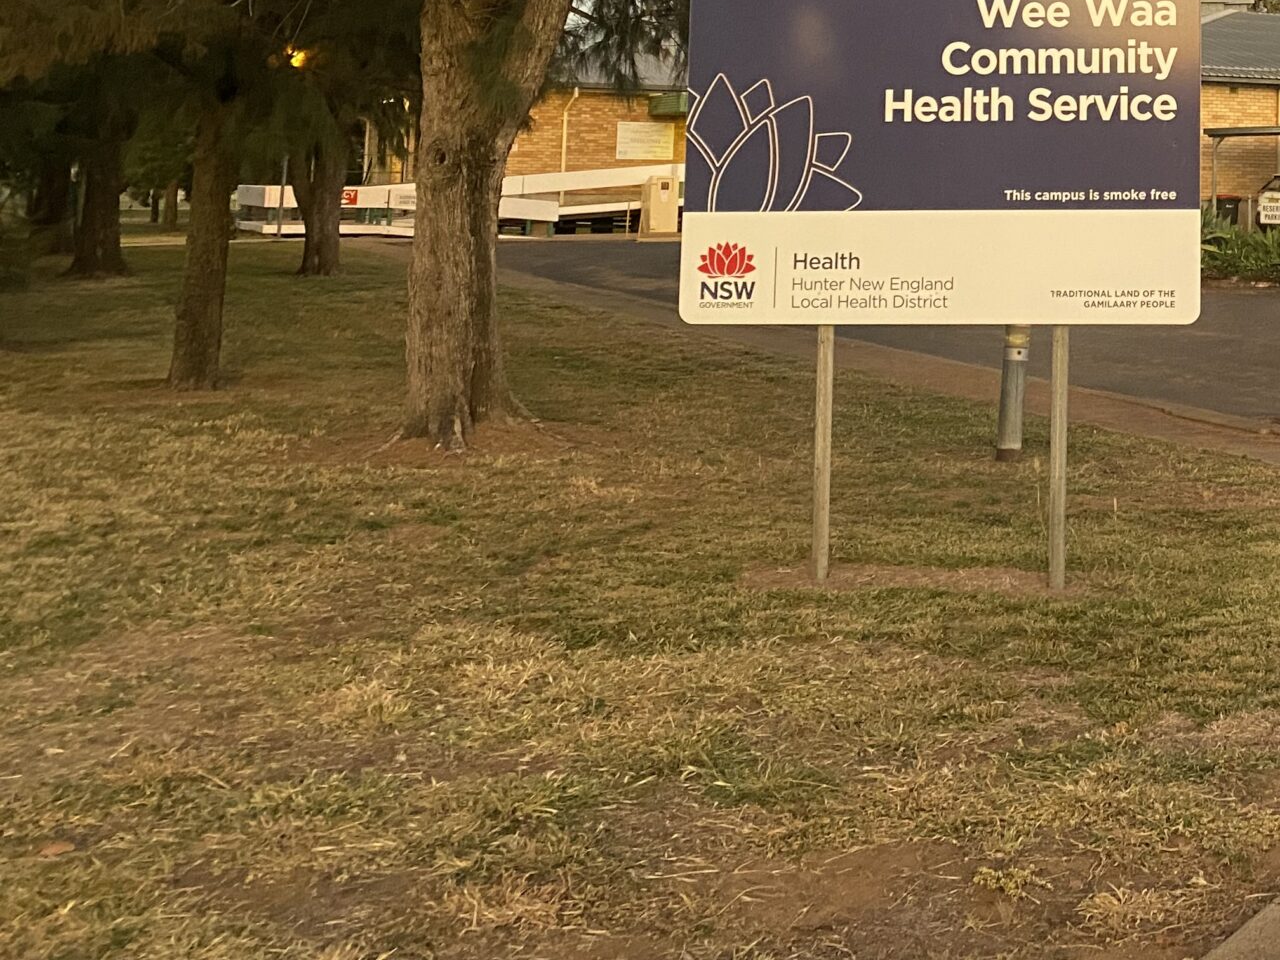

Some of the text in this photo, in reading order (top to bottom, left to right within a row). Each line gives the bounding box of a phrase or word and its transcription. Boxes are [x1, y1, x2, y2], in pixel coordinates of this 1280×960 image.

[941, 39, 1178, 81] Community
[884, 86, 1178, 122] Health Service
[1004, 189, 1177, 202] This campus is smoke free
[793, 252, 860, 270] Health
[700, 281, 756, 300] NSW
[792, 276, 954, 294] Hunter New England
[791, 294, 948, 309] Local Health District
[1050, 289, 1176, 298] TRADITIONAL LAND OF THE
[699, 301, 754, 309] GOVERNMENT
[1083, 300, 1176, 308] GAMILAARY PEOPLE
